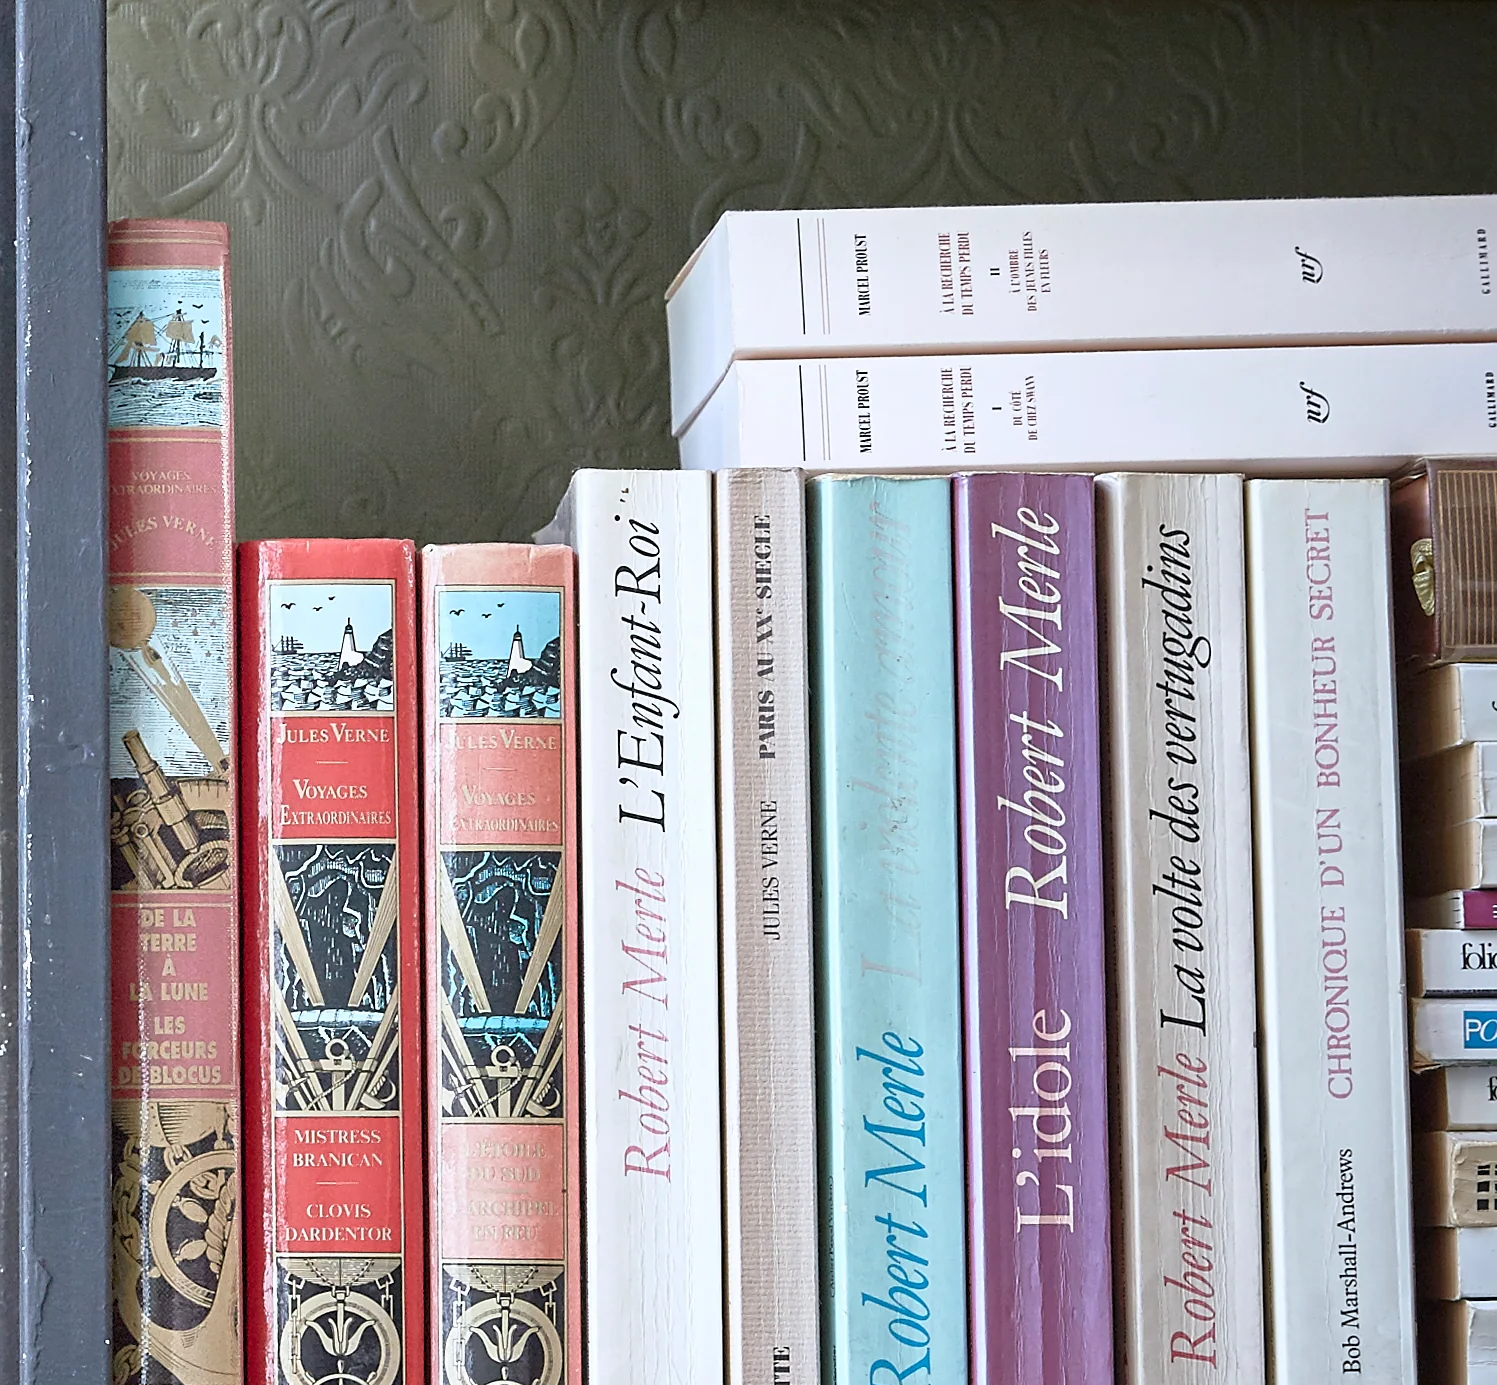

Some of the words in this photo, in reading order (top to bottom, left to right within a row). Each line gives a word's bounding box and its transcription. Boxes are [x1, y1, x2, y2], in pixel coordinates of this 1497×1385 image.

[855, 234, 868, 273] PROUST
[1479, 228, 1491, 295] GALLIMARD
[857, 275, 871, 316] MARCEL
[1299, 381, 1333, 424] nrf
[754, 514, 772, 601] SIECLE
[1304, 508, 1333, 621] SECRET
[990, 505, 1064, 694] Merle
[758, 651, 775, 683] AU
[1142, 523, 1213, 773] vertugadins
[277, 722, 329, 745] JULES
[332, 722, 390, 744] VERNE
[758, 689, 777, 760] PARIS
[1311, 637, 1341, 788] BONHEUR
[281, 805, 392, 826] EXTRAORDINAIRES
[293, 779, 368, 799] VOYAGES
[998, 711, 1069, 920] Robert
[1149, 778, 1201, 844] des
[760, 799, 779, 869] VERNE
[1318, 809, 1345, 887] D'UN
[762, 874, 781, 941] JULES
[1152, 854, 1204, 952] volte
[616, 867, 669, 1010] Merle
[161, 983, 208, 1001] LUNE
[294, 1129, 381, 1146] MISTRESS
[618, 1022, 671, 1184] Robert
[856, 1031, 928, 1208] Merle
[1009, 1008, 1075, 1234] L'idole
[1157, 1052, 1212, 1197] Merle
[292, 1153, 384, 1169] BRANICAN
[285, 1227, 392, 1243] DARDENTOR
[307, 1204, 371, 1219] CLOVIS
[1336, 1148, 1359, 1330] Marshall-Andrews
[1164, 1209, 1218, 1369] Robert
[1343, 1337, 1362, 1375] Bob
